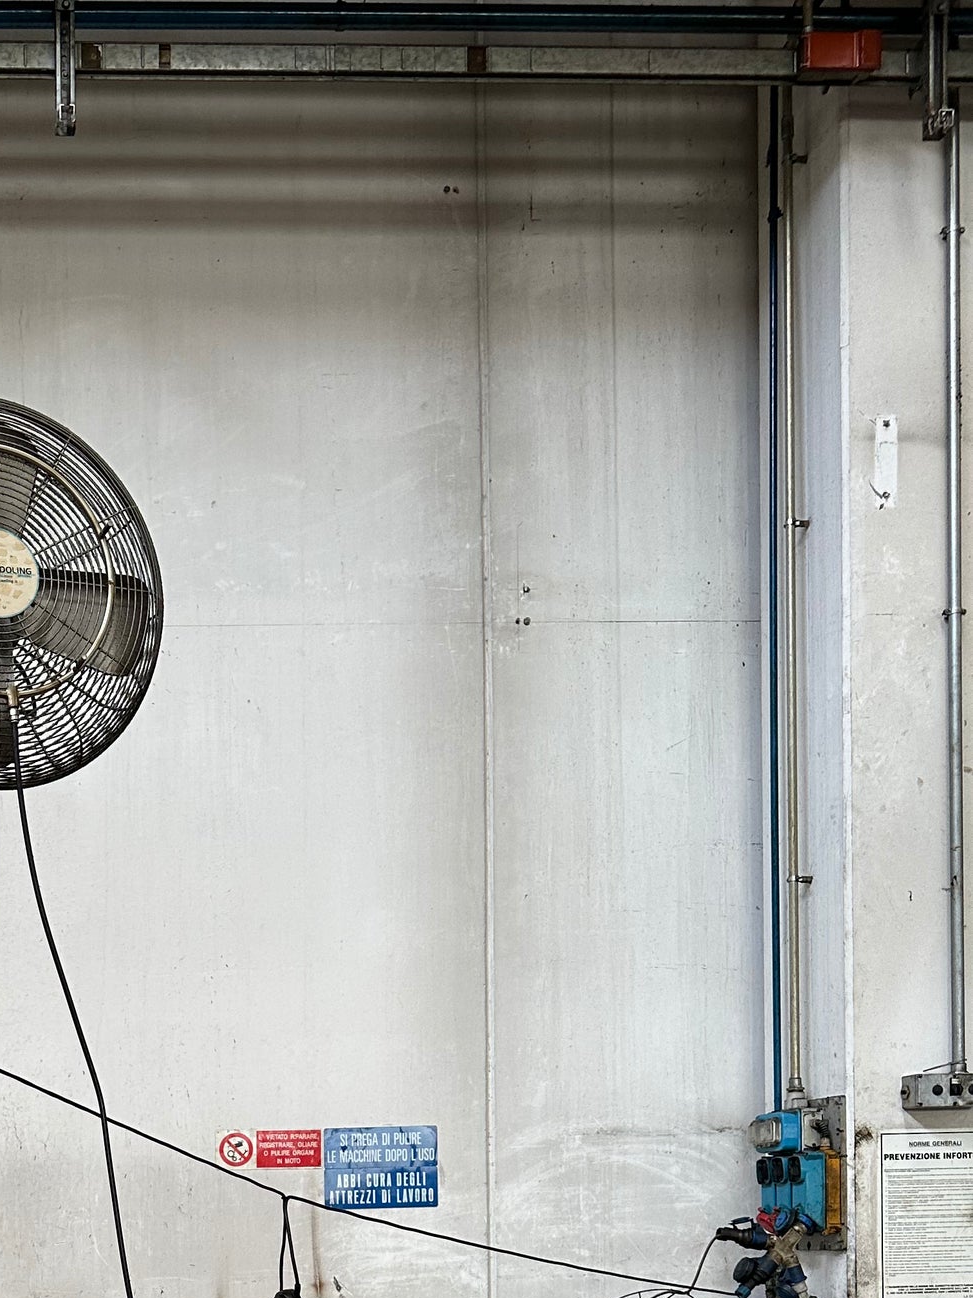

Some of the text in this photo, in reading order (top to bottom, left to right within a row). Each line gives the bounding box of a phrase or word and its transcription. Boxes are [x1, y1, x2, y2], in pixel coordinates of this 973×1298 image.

[340, 1131, 422, 1147] SI PREGA DI PULIRE
[327, 1147, 435, 1164] LE MACCHINE DOPO L'USO
[883, 1151, 973, 1161] PREVENZIONE INFORT
[337, 1171, 427, 1188] ABBI CURA DEGLI
[329, 1187, 434, 1204] ATTREZZI DI LAVORO
